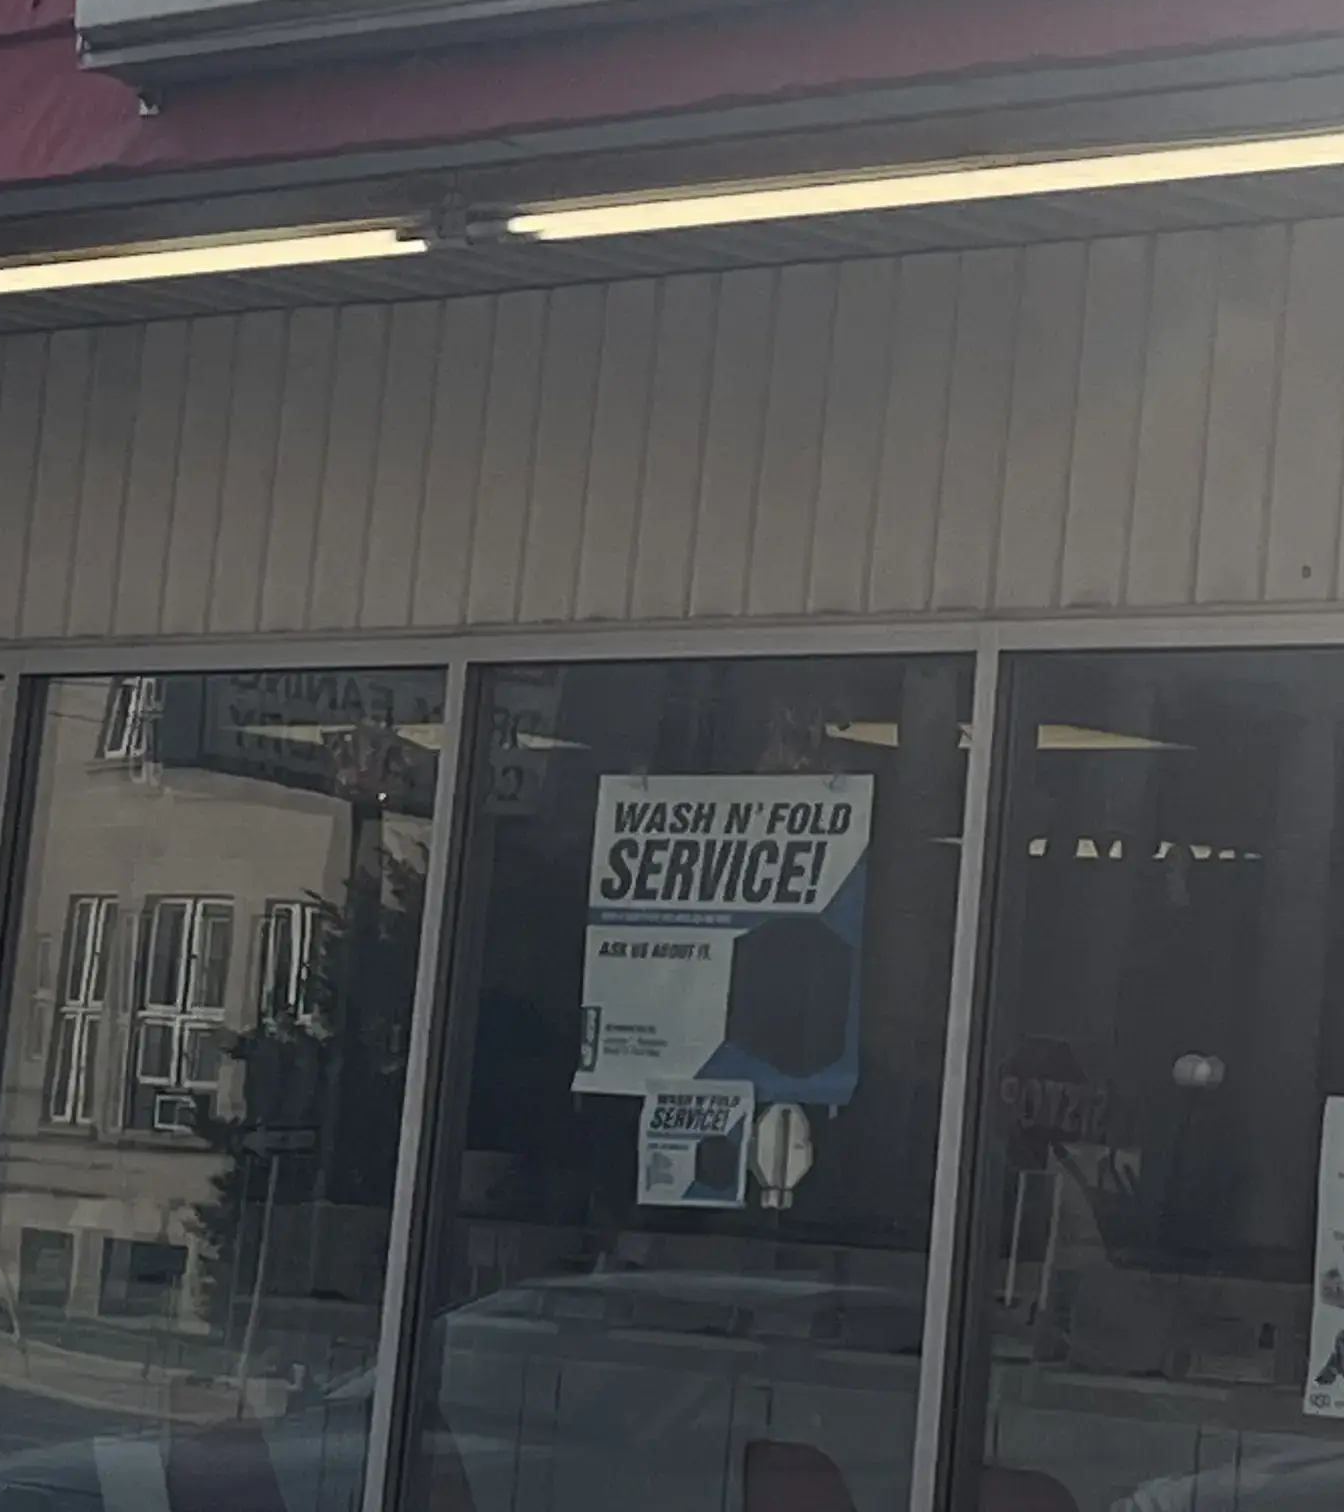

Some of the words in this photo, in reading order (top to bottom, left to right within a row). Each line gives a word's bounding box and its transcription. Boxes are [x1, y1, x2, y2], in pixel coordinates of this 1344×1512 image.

[613, 800, 718, 835] WASH
[765, 801, 853, 836] FOLD
[599, 838, 829, 906] SERVICE!
